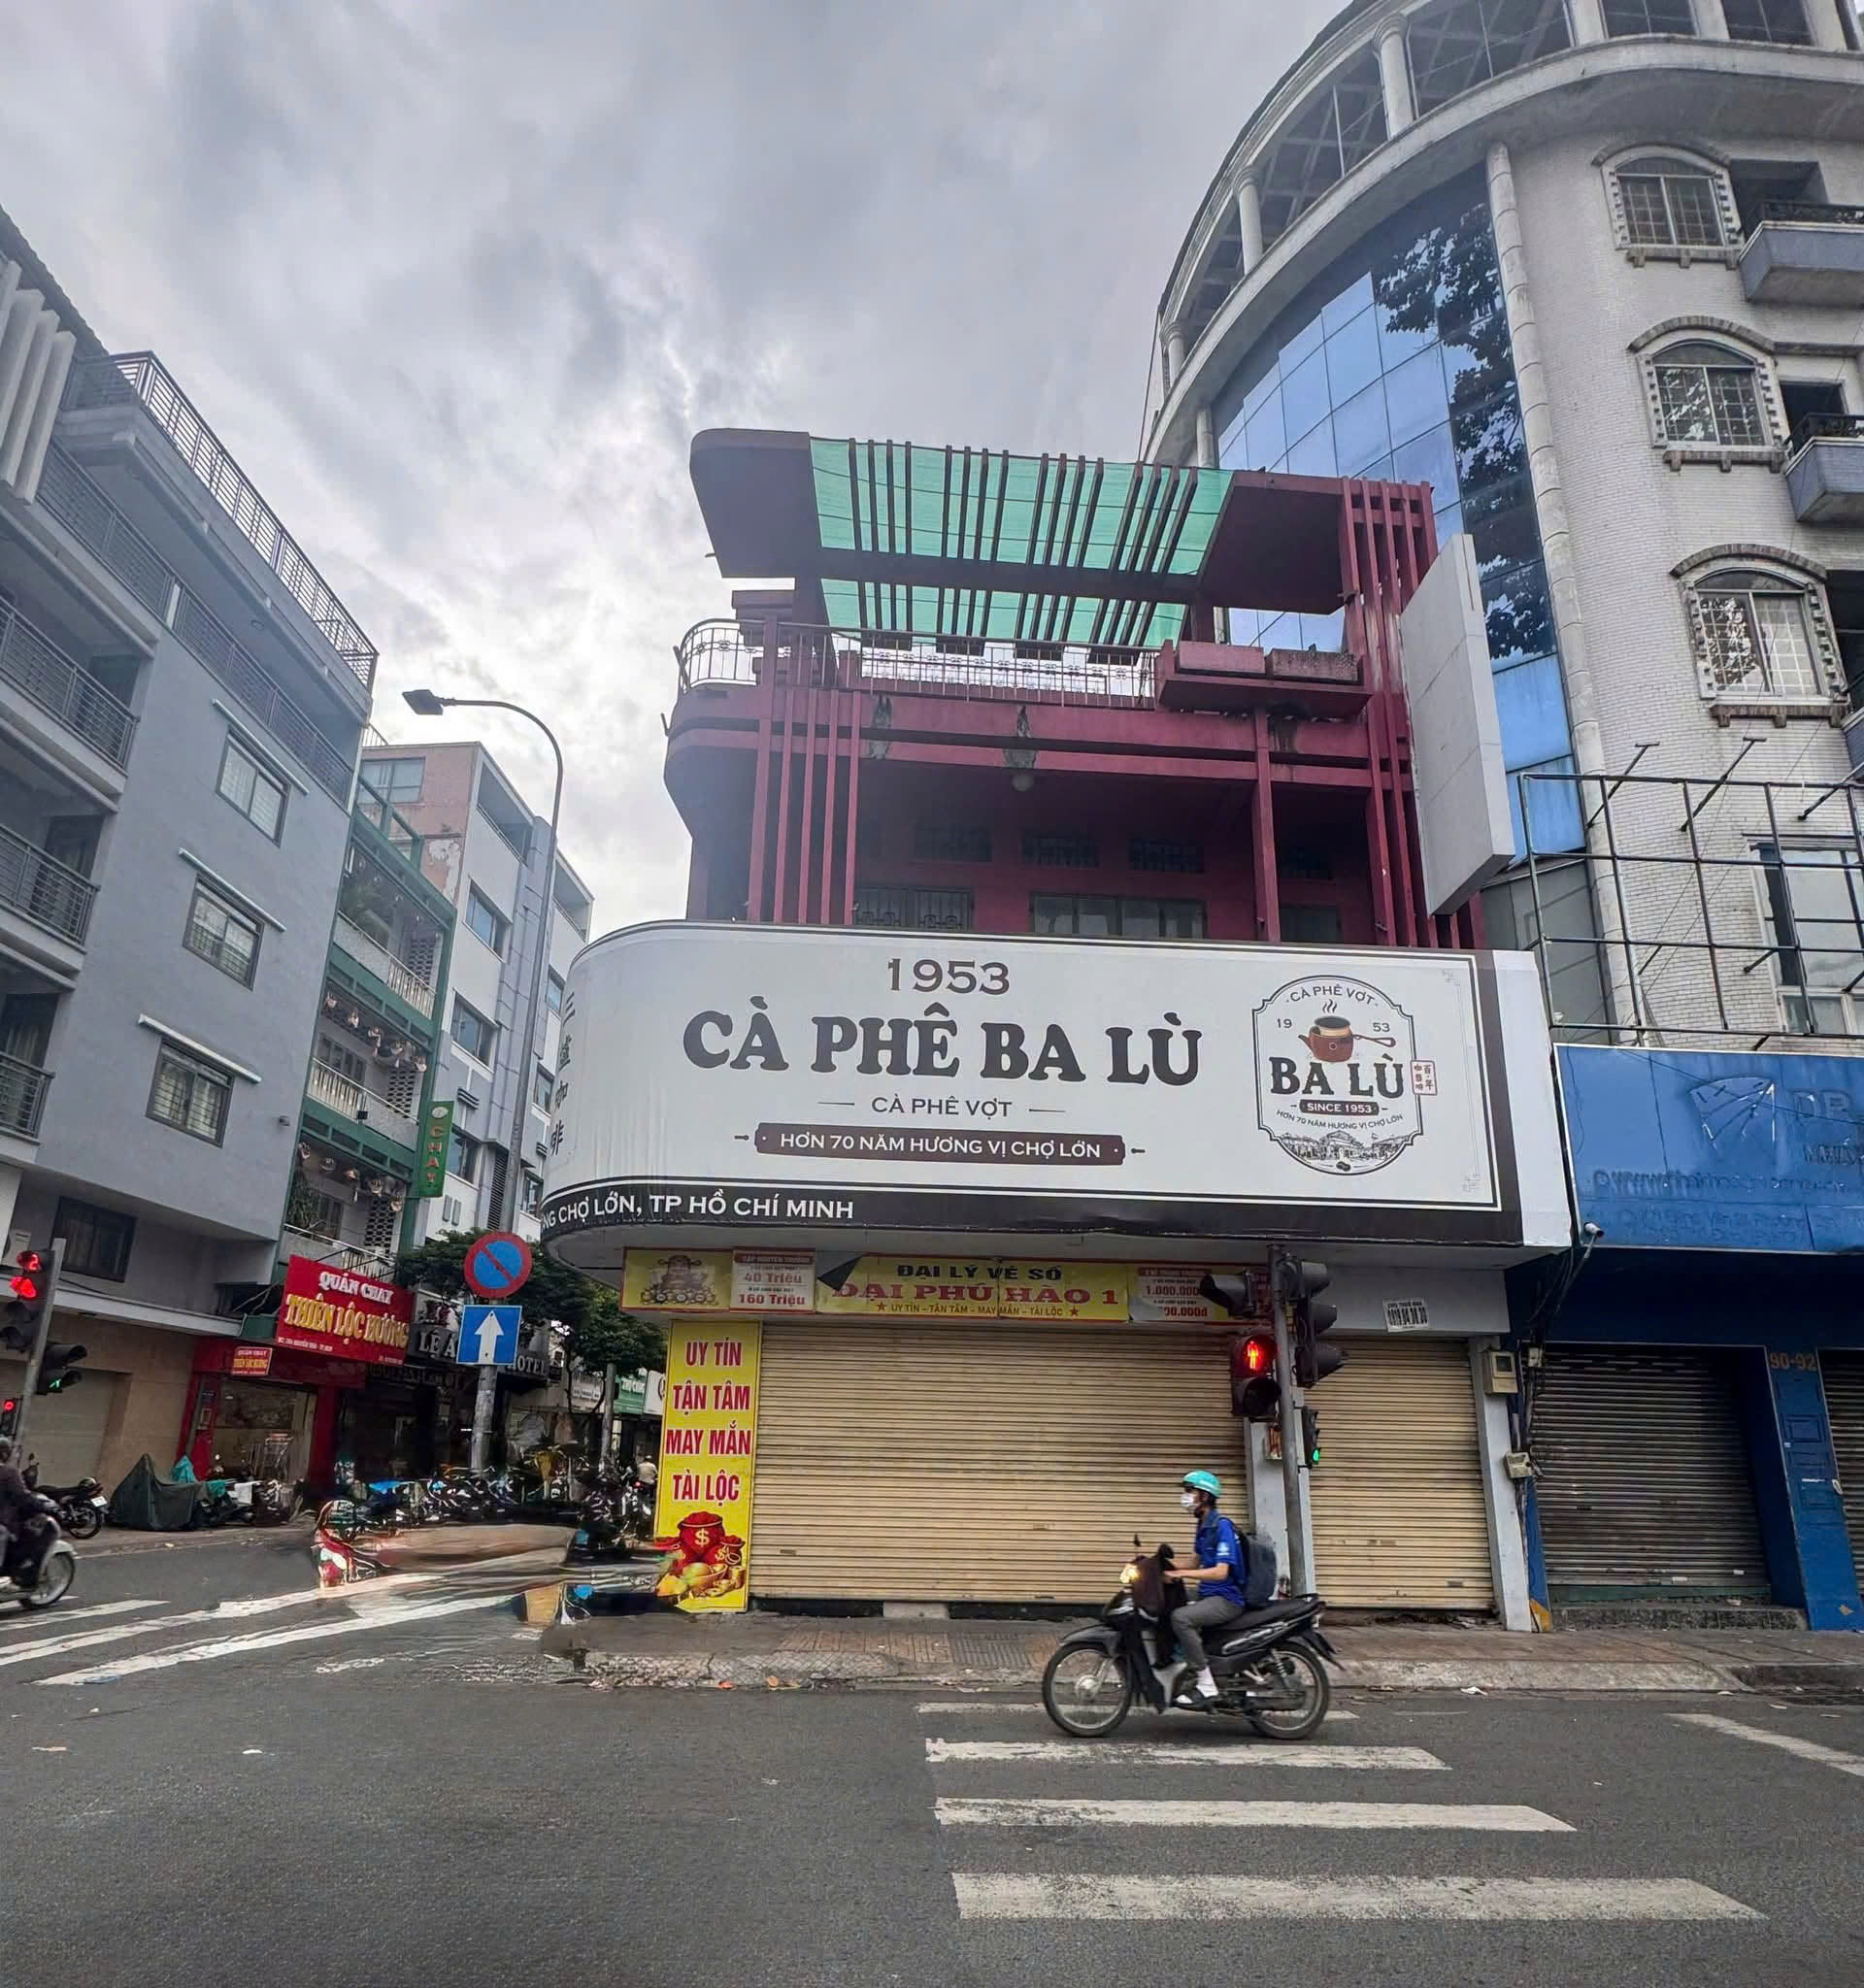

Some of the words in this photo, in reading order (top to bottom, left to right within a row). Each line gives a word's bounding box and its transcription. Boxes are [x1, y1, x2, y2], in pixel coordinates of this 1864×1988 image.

[887, 957, 1010, 995] 1953
[1289, 986, 1311, 1002] CÀ
[1313, 983, 1343, 996] PHÊ
[1346, 987, 1375, 1006] VỢT
[1277, 1018, 1292, 1029] 19
[1373, 1022, 1390, 1033] 53
[682, 995, 789, 1072] CÀ
[811, 1002, 960, 1077] PHÊ
[981, 1022, 1086, 1081] BA
[1105, 1012, 1203, 1086] LÙ
[1269, 1056, 1335, 1095] BA
[1347, 1052, 1404, 1099] LÙ
[871, 1094, 905, 1114] CÀ
[912, 1095, 959, 1116] PHÊ
[966, 1100, 1013, 1120] VỢT
[1307, 1102, 1343, 1112] SINCE
[1345, 1104, 1373, 1113] 1953
[781, 1132, 825, 1149] HƠN
[830, 1135, 855, 1150] 70
[859, 1134, 905, 1152] NĂM
[910, 1137, 983, 1154] HƯƠNG
[987, 1140, 1007, 1159] VỊ
[1011, 1140, 1055, 1160] CHỢ
[1059, 1139, 1101, 1158] LỚN
[542, 1210, 556, 1230] NG
[558, 1196, 589, 1222] CHỢ
[594, 1192, 643, 1216] LỚN,
[649, 1194, 682, 1214] TP
[688, 1188, 726, 1215] HỒ
[734, 1193, 778, 1217] CHÍ
[786, 1199, 853, 1219] MINH
[745, 1273, 761, 1282] 40
[949, 1264, 979, 1278] LÝ
[987, 1265, 1018, 1280] VÉ
[360, 1282, 394, 1305] CHAY
[739, 1293, 764, 1305] 160
[1102, 1289, 1118, 1305] 1
[1146, 1285, 1202, 1296] 1.000.000
[284, 1292, 336, 1333] THIÊN
[334, 1301, 366, 1344] LỘC
[685, 1342, 709, 1367] UY
[714, 1337, 742, 1367] TÍN
[1770, 1351, 1817, 1371] 90-92
[512, 1355, 546, 1375] OTEL
[673, 1379, 707, 1415] TẬN
[713, 1379, 750, 1410] TÂM
[665, 1429, 705, 1455] MAY
[709, 1419, 751, 1455] MẮN
[673, 1469, 700, 1501] TÀI
[705, 1469, 740, 1507] LỘC
